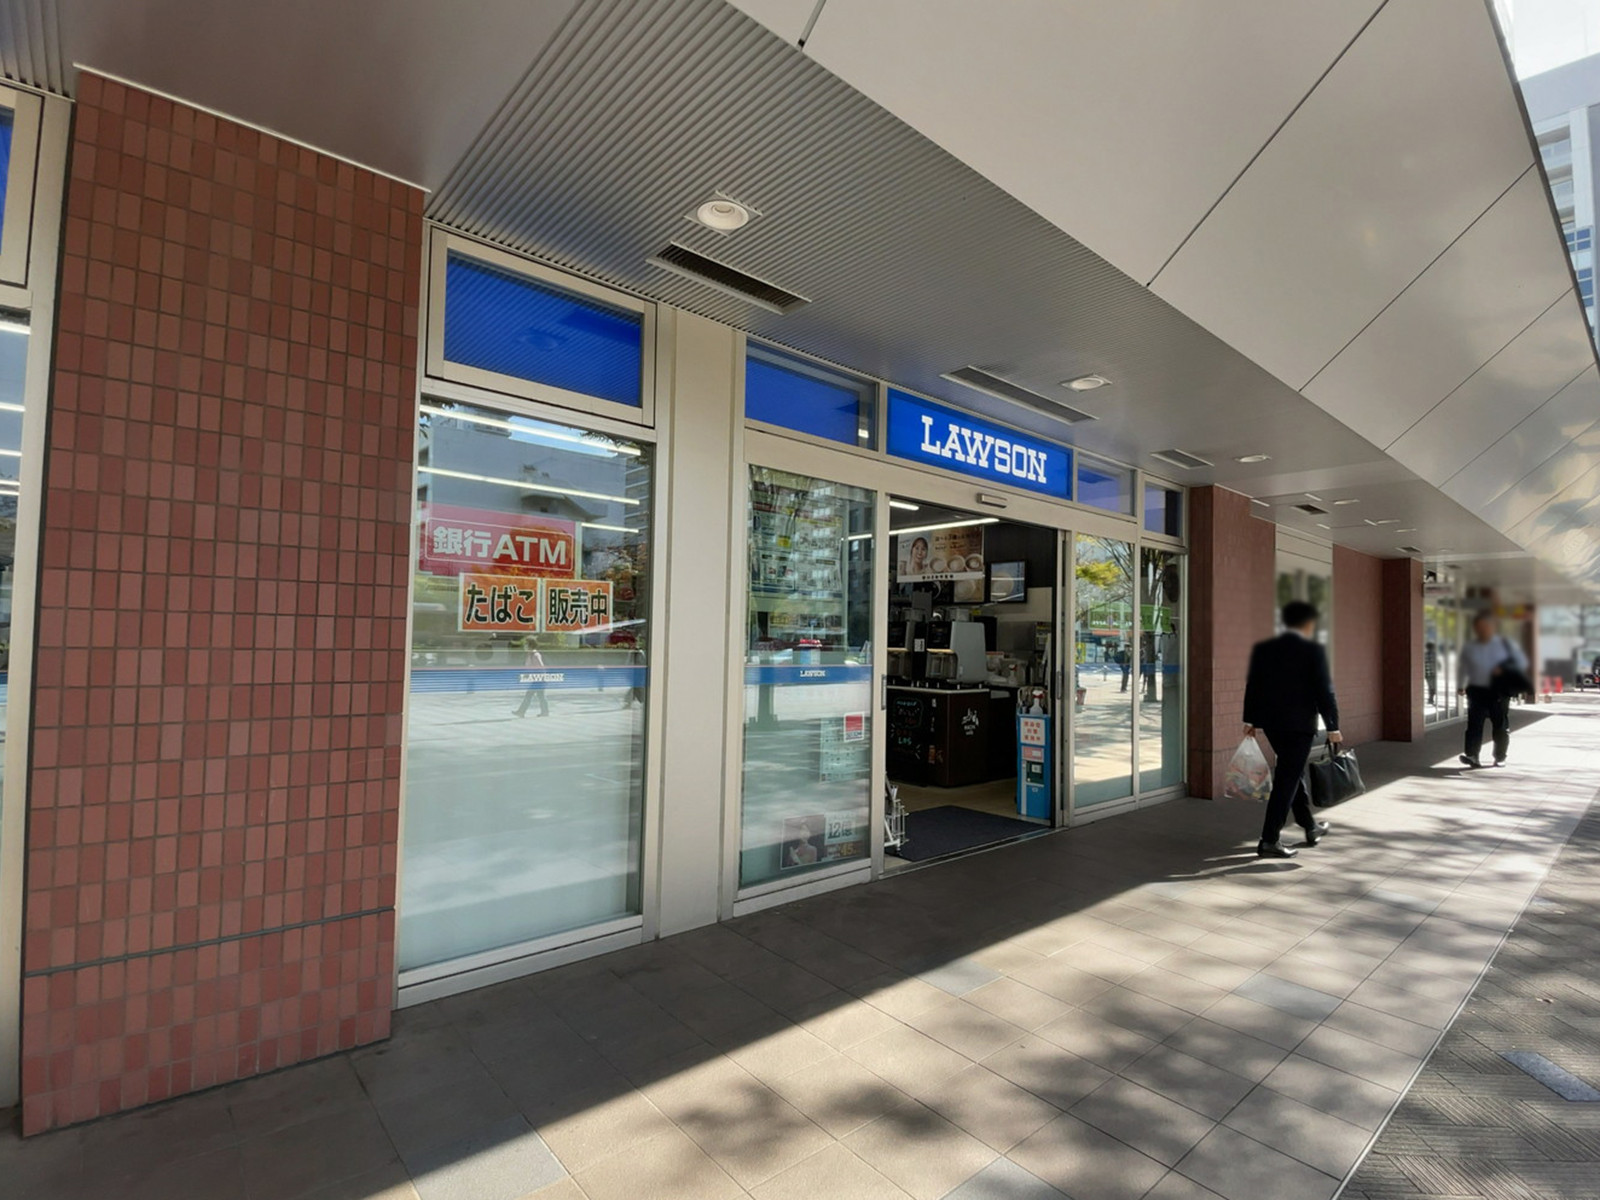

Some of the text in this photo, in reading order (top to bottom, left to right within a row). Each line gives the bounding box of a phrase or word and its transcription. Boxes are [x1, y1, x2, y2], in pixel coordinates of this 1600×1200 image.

[921, 414, 1047, 484] LAWSON
[432, 525, 566, 566] 銀行ATM
[465, 583, 608, 625] たばこ 販売中
[520, 672, 564, 683] LAWSON
